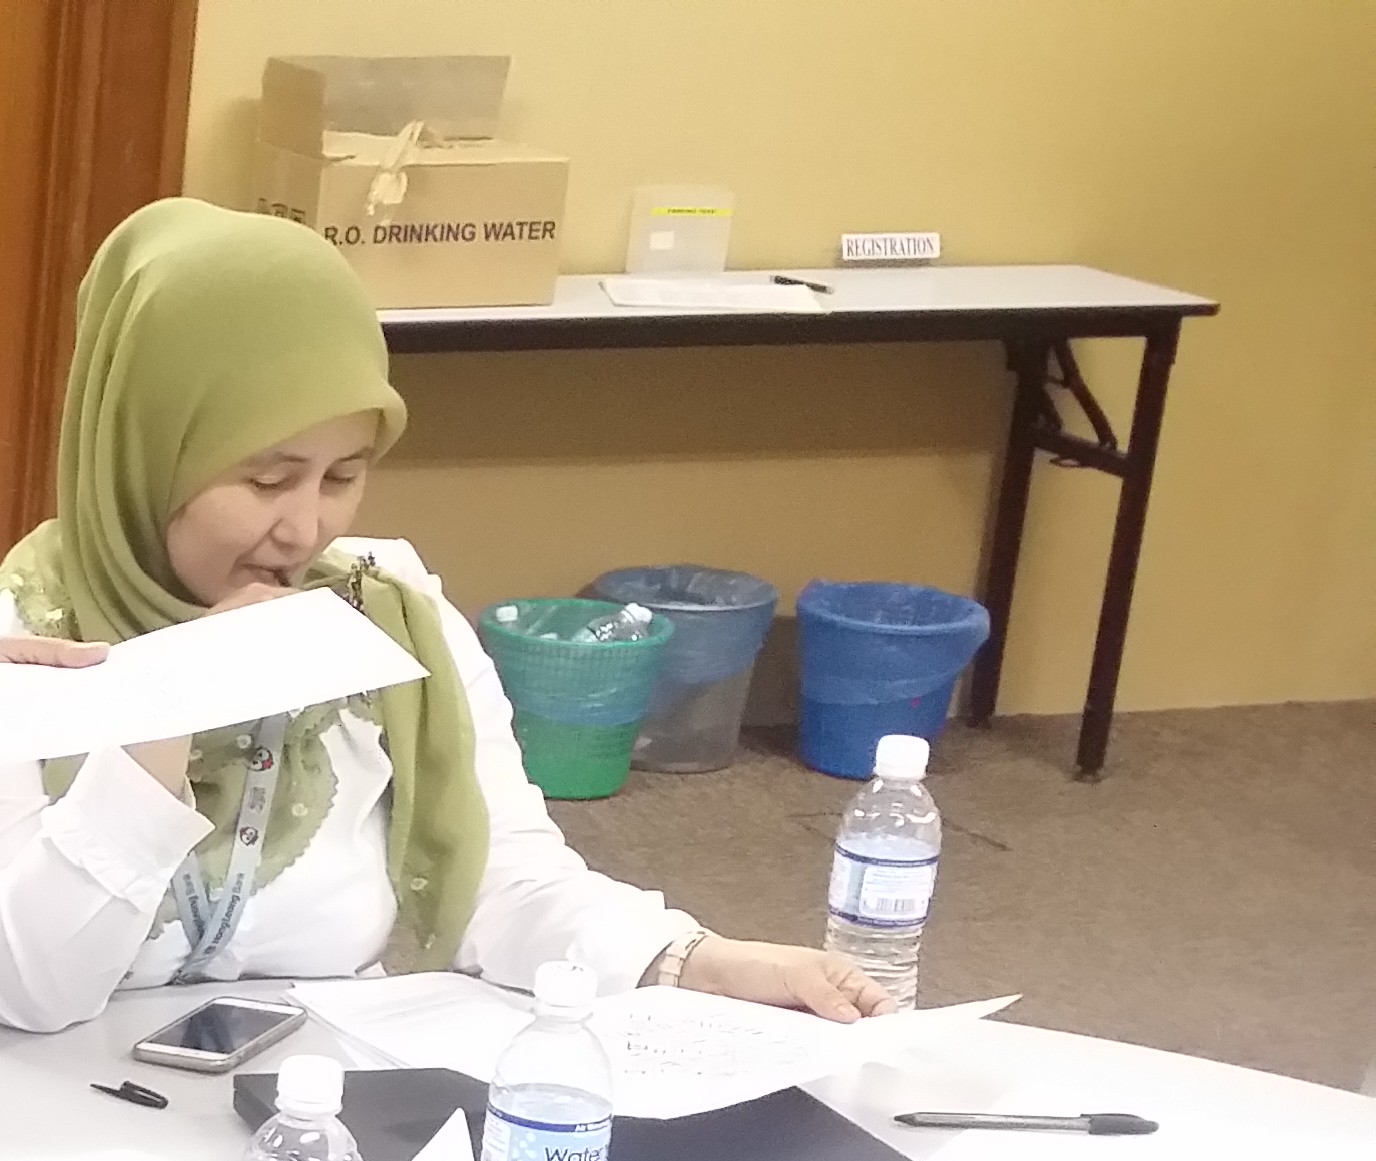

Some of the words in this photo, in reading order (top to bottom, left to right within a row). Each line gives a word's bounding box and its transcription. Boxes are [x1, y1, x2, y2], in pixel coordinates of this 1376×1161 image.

[324, 226, 365, 246] R.O.
[373, 221, 477, 245] DRINKING
[483, 220, 556, 242] WATER
[846, 237, 935, 257] REGISTRATION
